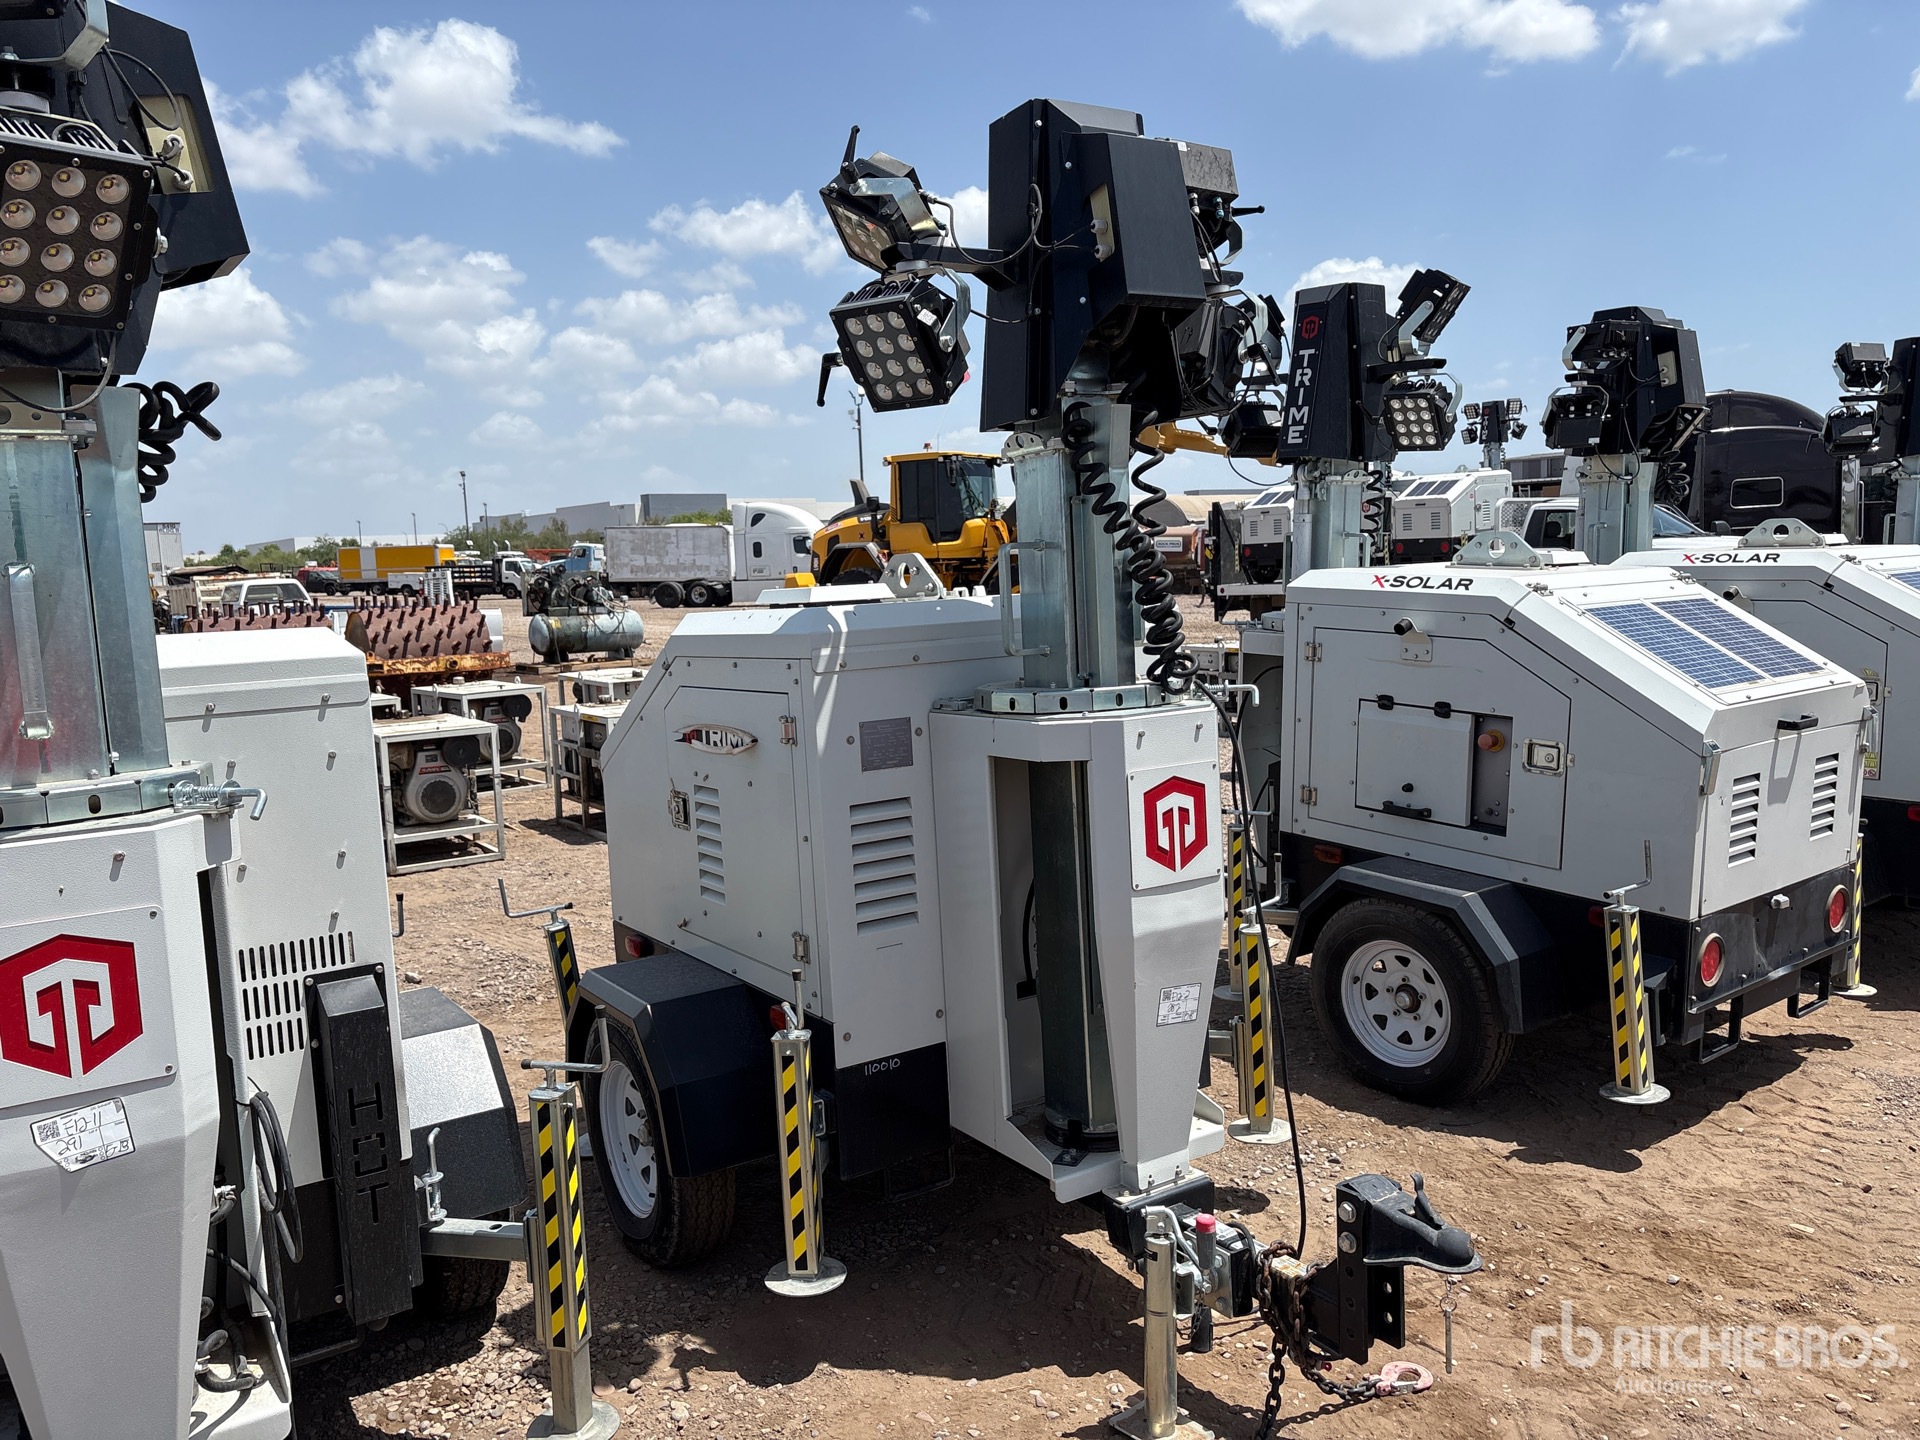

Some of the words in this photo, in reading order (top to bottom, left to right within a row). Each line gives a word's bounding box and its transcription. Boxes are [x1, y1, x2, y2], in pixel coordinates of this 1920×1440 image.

[1287, 349, 1316, 444] TRIME
[1682, 553, 1780, 564] X-SOLAR
[1371, 575, 1474, 591] X-SOLAR
[865, 1058, 900, 1076] 110010
[56, 1135, 82, 1155] 291
[348, 1081, 389, 1225] HOT
